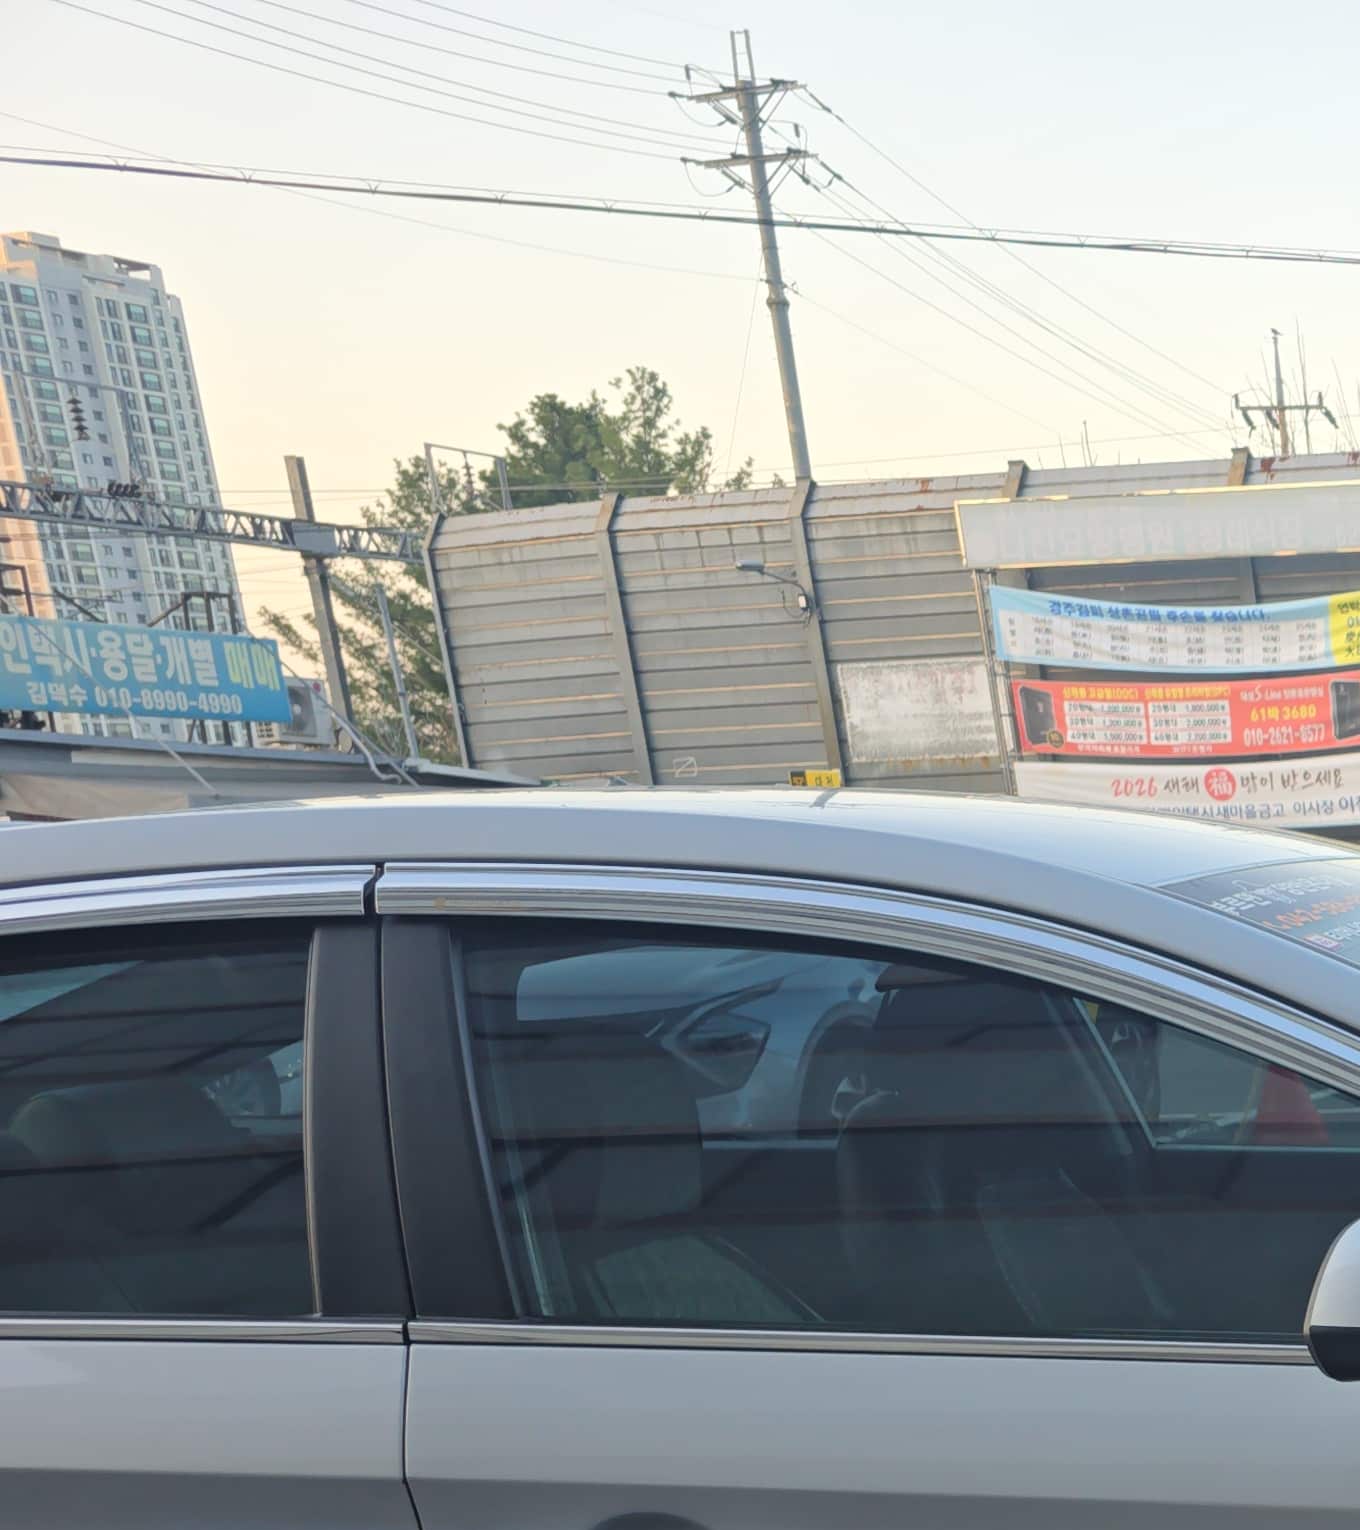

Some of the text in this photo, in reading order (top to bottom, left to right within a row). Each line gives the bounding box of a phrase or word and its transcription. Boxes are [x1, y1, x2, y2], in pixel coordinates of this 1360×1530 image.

[223, 641, 280, 691] 매매
[1283, 704, 1316, 720] 3680
[1111, 776, 1158, 797] 2026
[1208, 769, 1233, 798] 福
[1241, 770, 1274, 793] 많이
[1281, 767, 1345, 791] 받으세요
[1294, 798, 1333, 816] 이사장
